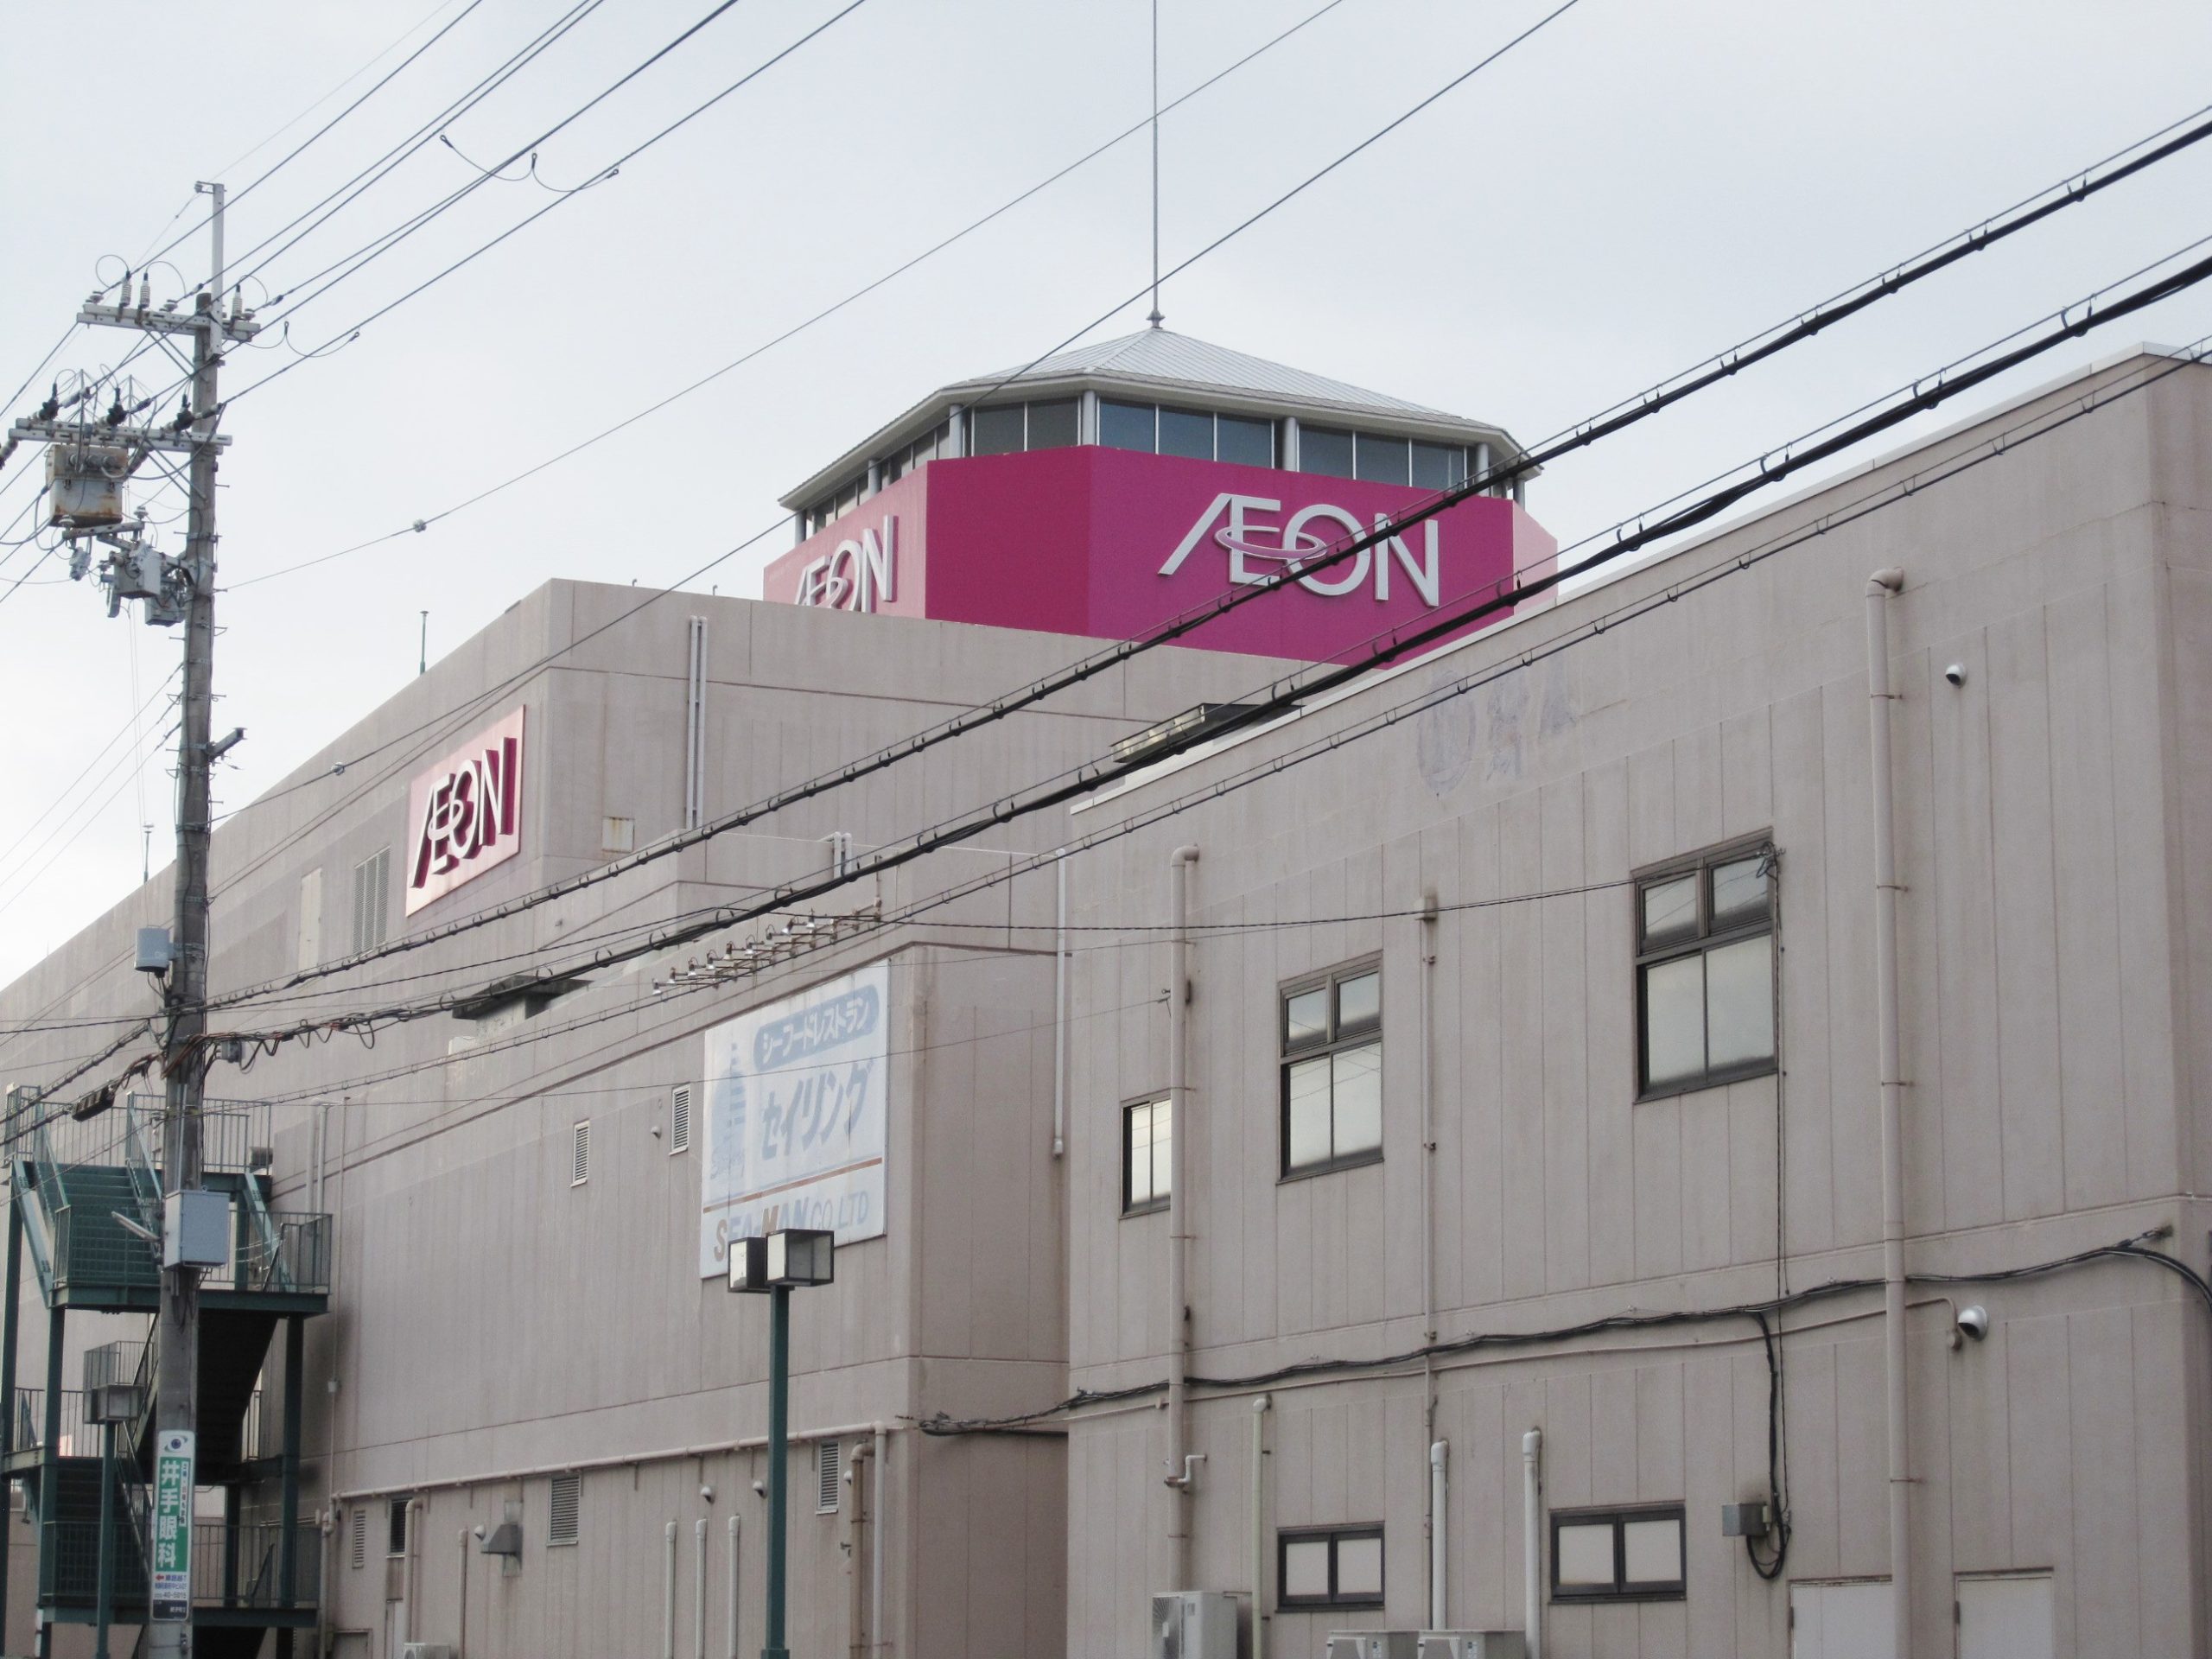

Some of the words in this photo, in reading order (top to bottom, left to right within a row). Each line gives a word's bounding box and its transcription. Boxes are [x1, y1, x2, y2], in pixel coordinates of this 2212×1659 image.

[762, 997, 869, 1065] シーフードレストラン
[761, 1058, 874, 1160] セイリング
[157, 1459, 181, 1568] 井手眼科
